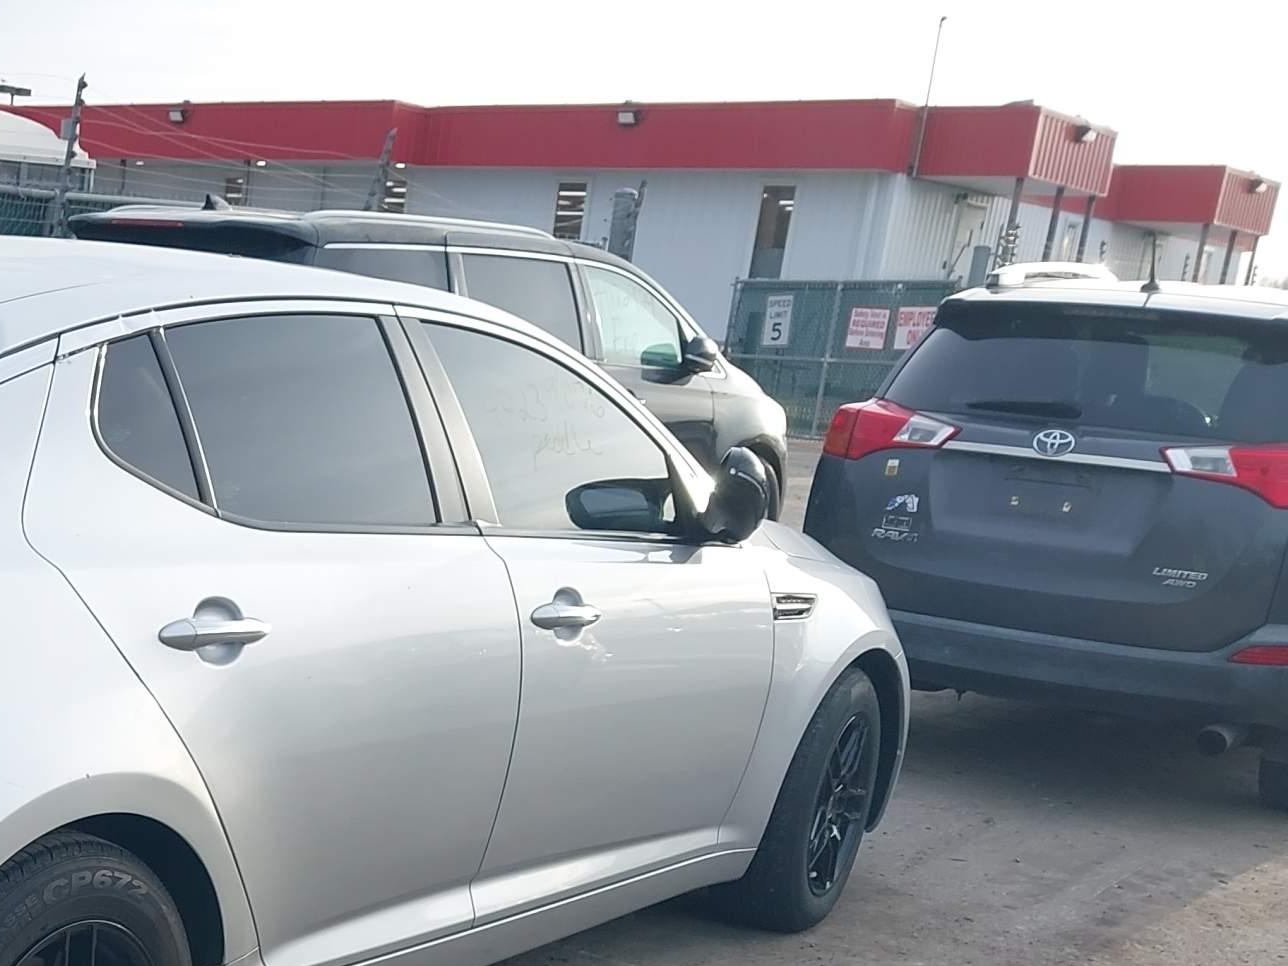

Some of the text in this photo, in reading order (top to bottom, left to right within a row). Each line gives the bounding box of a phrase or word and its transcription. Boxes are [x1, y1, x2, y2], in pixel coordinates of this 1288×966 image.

[769, 299, 792, 308] SPEED
[769, 310, 788, 320] LIMIT
[852, 319, 886, 329] REQUIRED
[770, 322, 782, 341] 5
[1152, 567, 1209, 580] LIMITED
[1162, 578, 1197, 588] AWD
[43, 869, 149, 905] CP672
